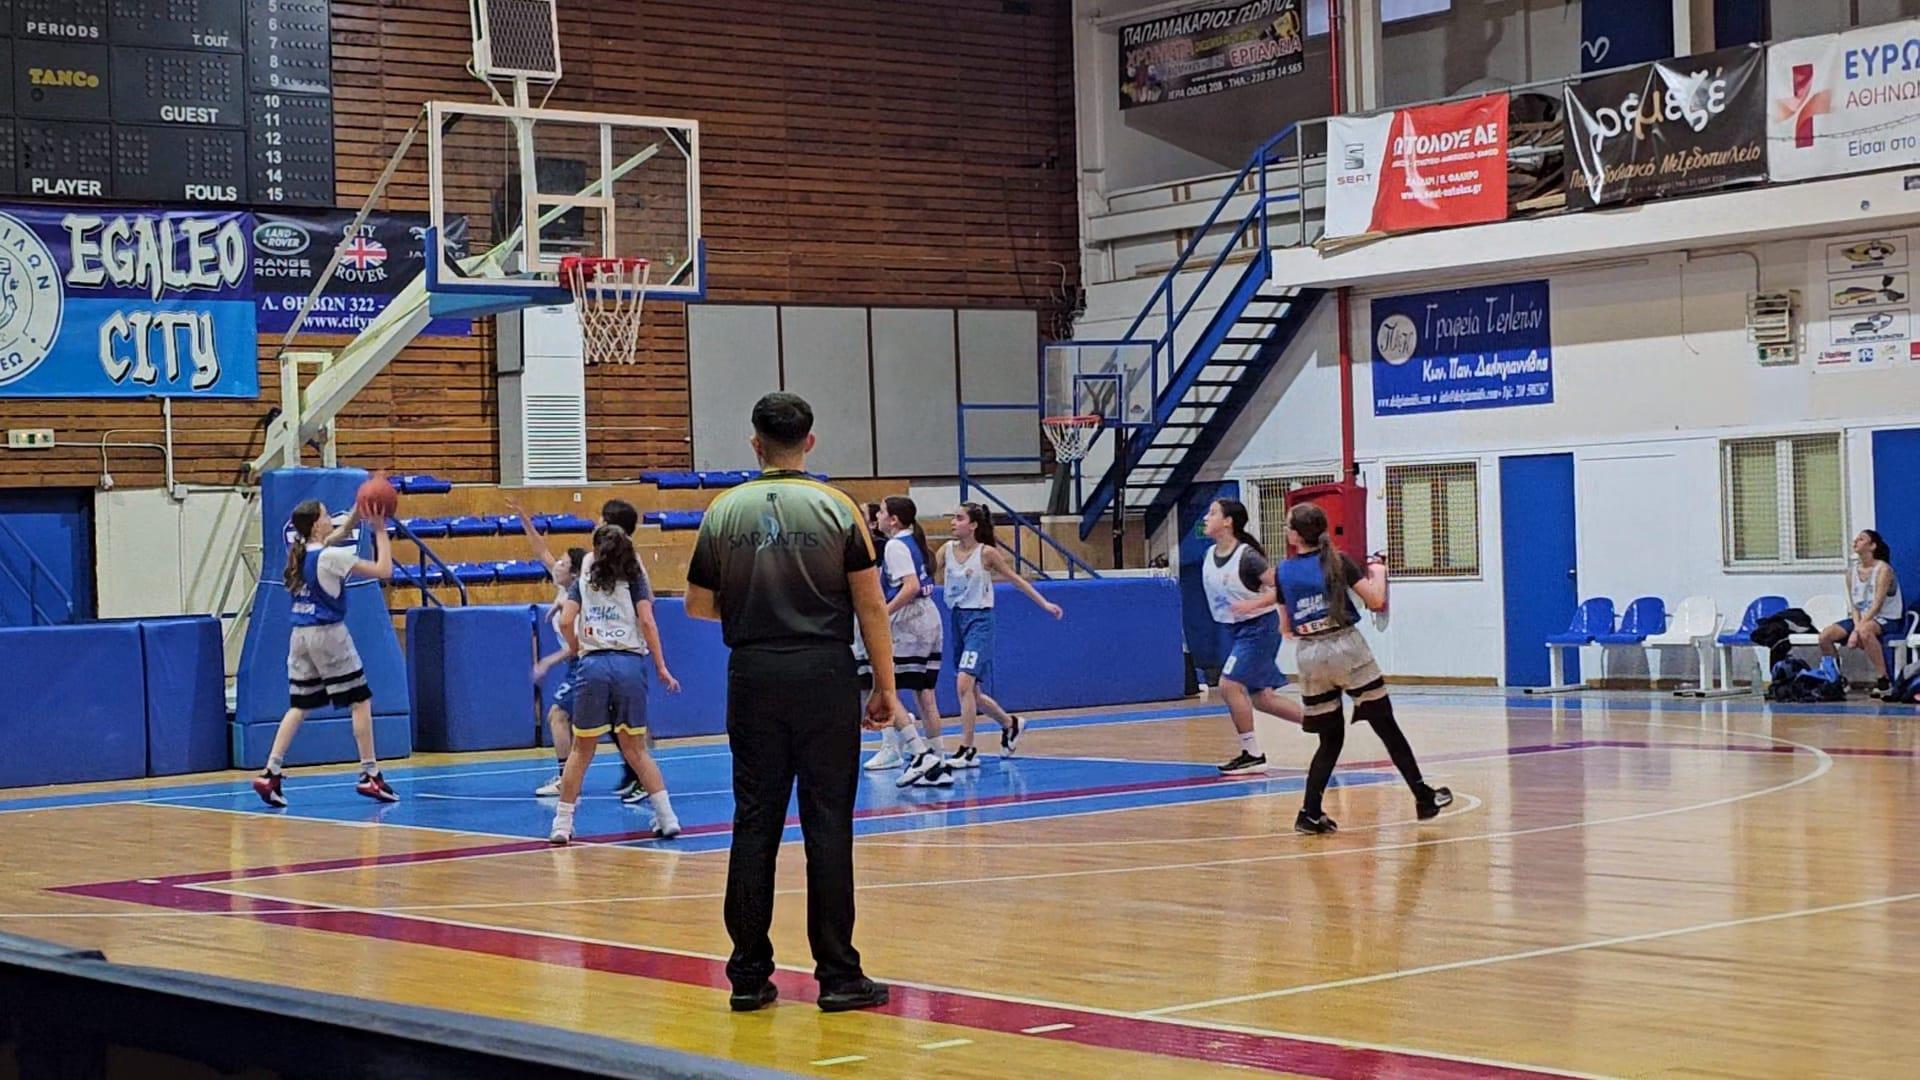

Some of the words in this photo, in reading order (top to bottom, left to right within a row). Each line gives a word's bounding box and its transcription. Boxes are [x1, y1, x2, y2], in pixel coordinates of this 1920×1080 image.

[27, 22, 99, 38] PERIODS
[268, 19, 277, 31] 6
[1124, 10, 1235, 47] ΠΑΠΑΜΑΚΑΡΙΟΣ
[206, 36, 229, 48] OUT
[269, 37, 278, 49] 7
[1228, 36, 1303, 69] ΕΡΓΑΛΕΙΑ
[269, 55, 278, 68] 8
[1845, 39, 1920, 81] ΕΥΡΩ
[270, 74, 279, 87] 9
[264, 95, 280, 108] 10
[160, 105, 219, 124] GUEST
[265, 114, 280, 127] 11
[265, 132, 281, 145] 12
[1848, 139, 1886, 158] Είσαι
[1890, 137, 1917, 153] στο
[266, 150, 281, 164] 13
[266, 169, 282, 182] 14
[1336, 173, 1373, 187] SEAT
[32, 178, 102, 196] PLAYER
[185, 185, 237, 202] FOULS
[267, 187, 282, 201] 15
[62, 213, 248, 303] EGALEO
[254, 258, 311, 268] RANGE
[254, 268, 312, 278] ROVER
[335, 265, 389, 284] ROVER
[350, 295, 375, 311] 322
[99, 310, 222, 391] CITY
[728, 531, 819, 551] SARANTIS
